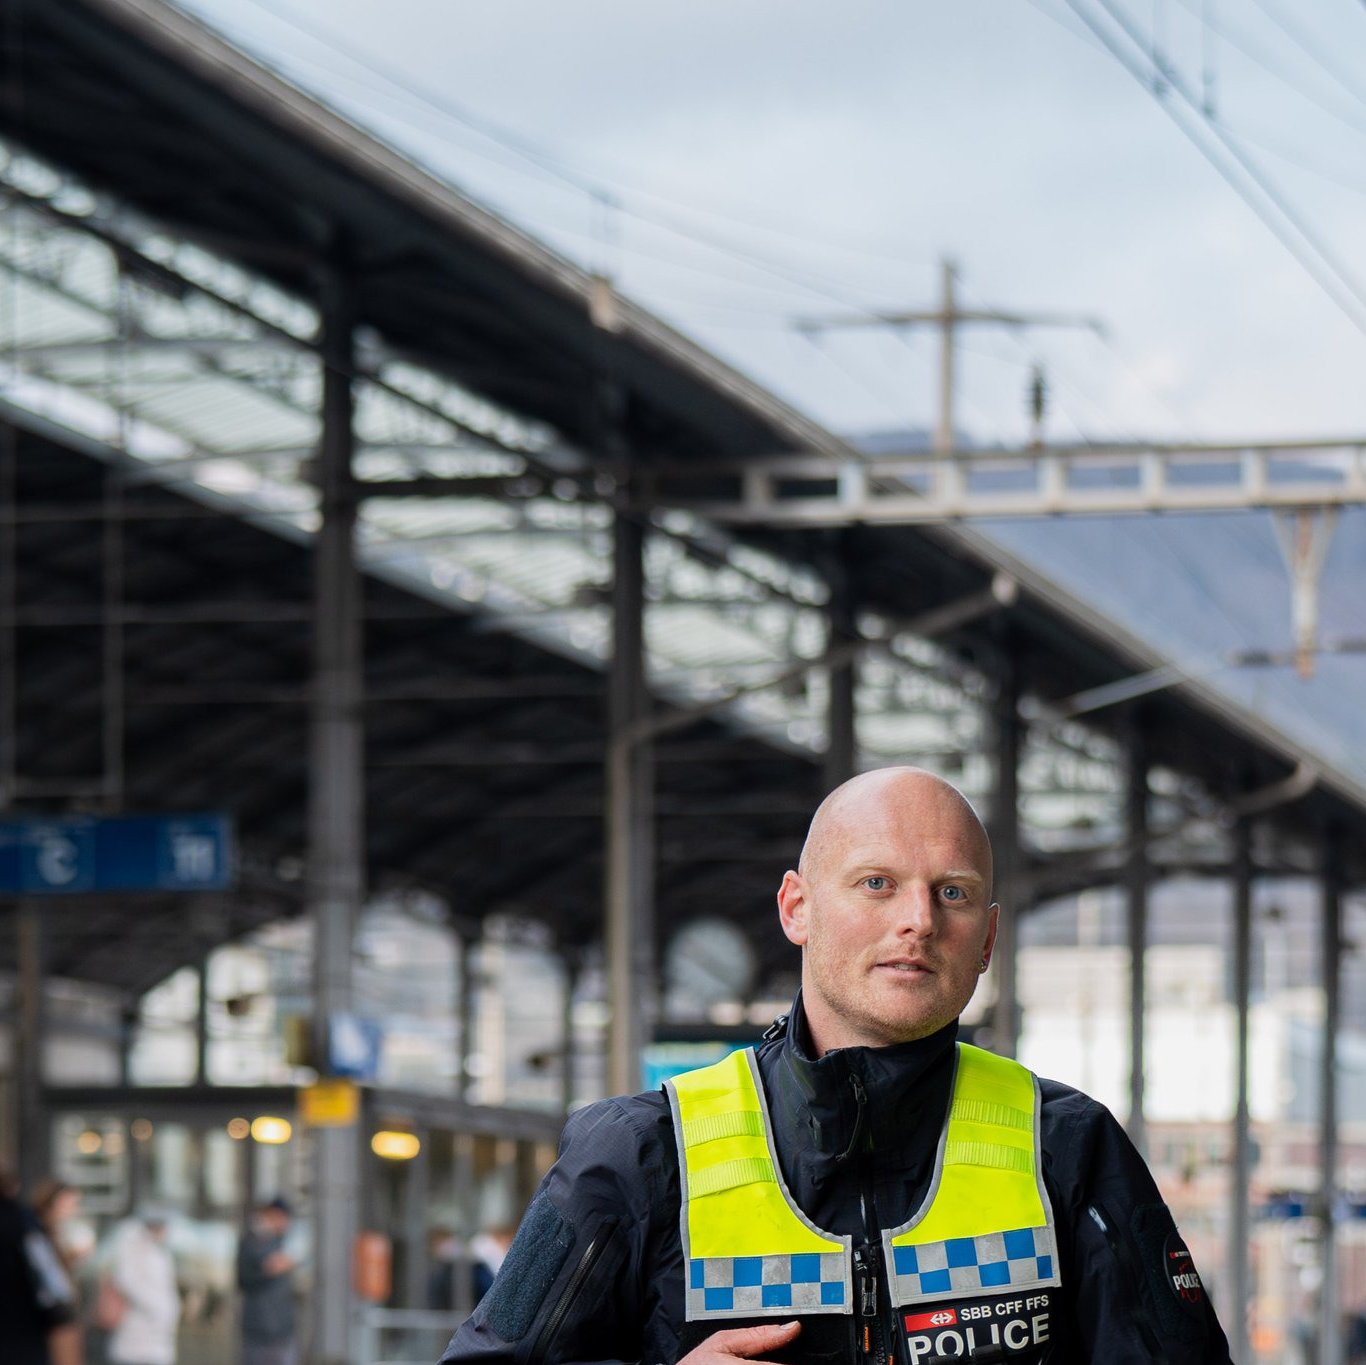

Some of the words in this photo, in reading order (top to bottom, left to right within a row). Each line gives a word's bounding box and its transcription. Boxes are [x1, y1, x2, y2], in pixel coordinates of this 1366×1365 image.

[960, 1305, 992, 1321] SBB
[995, 1300, 1023, 1316] CFF
[1026, 1295, 1049, 1311] FFS
[907, 1313, 1050, 1365] POLICE
